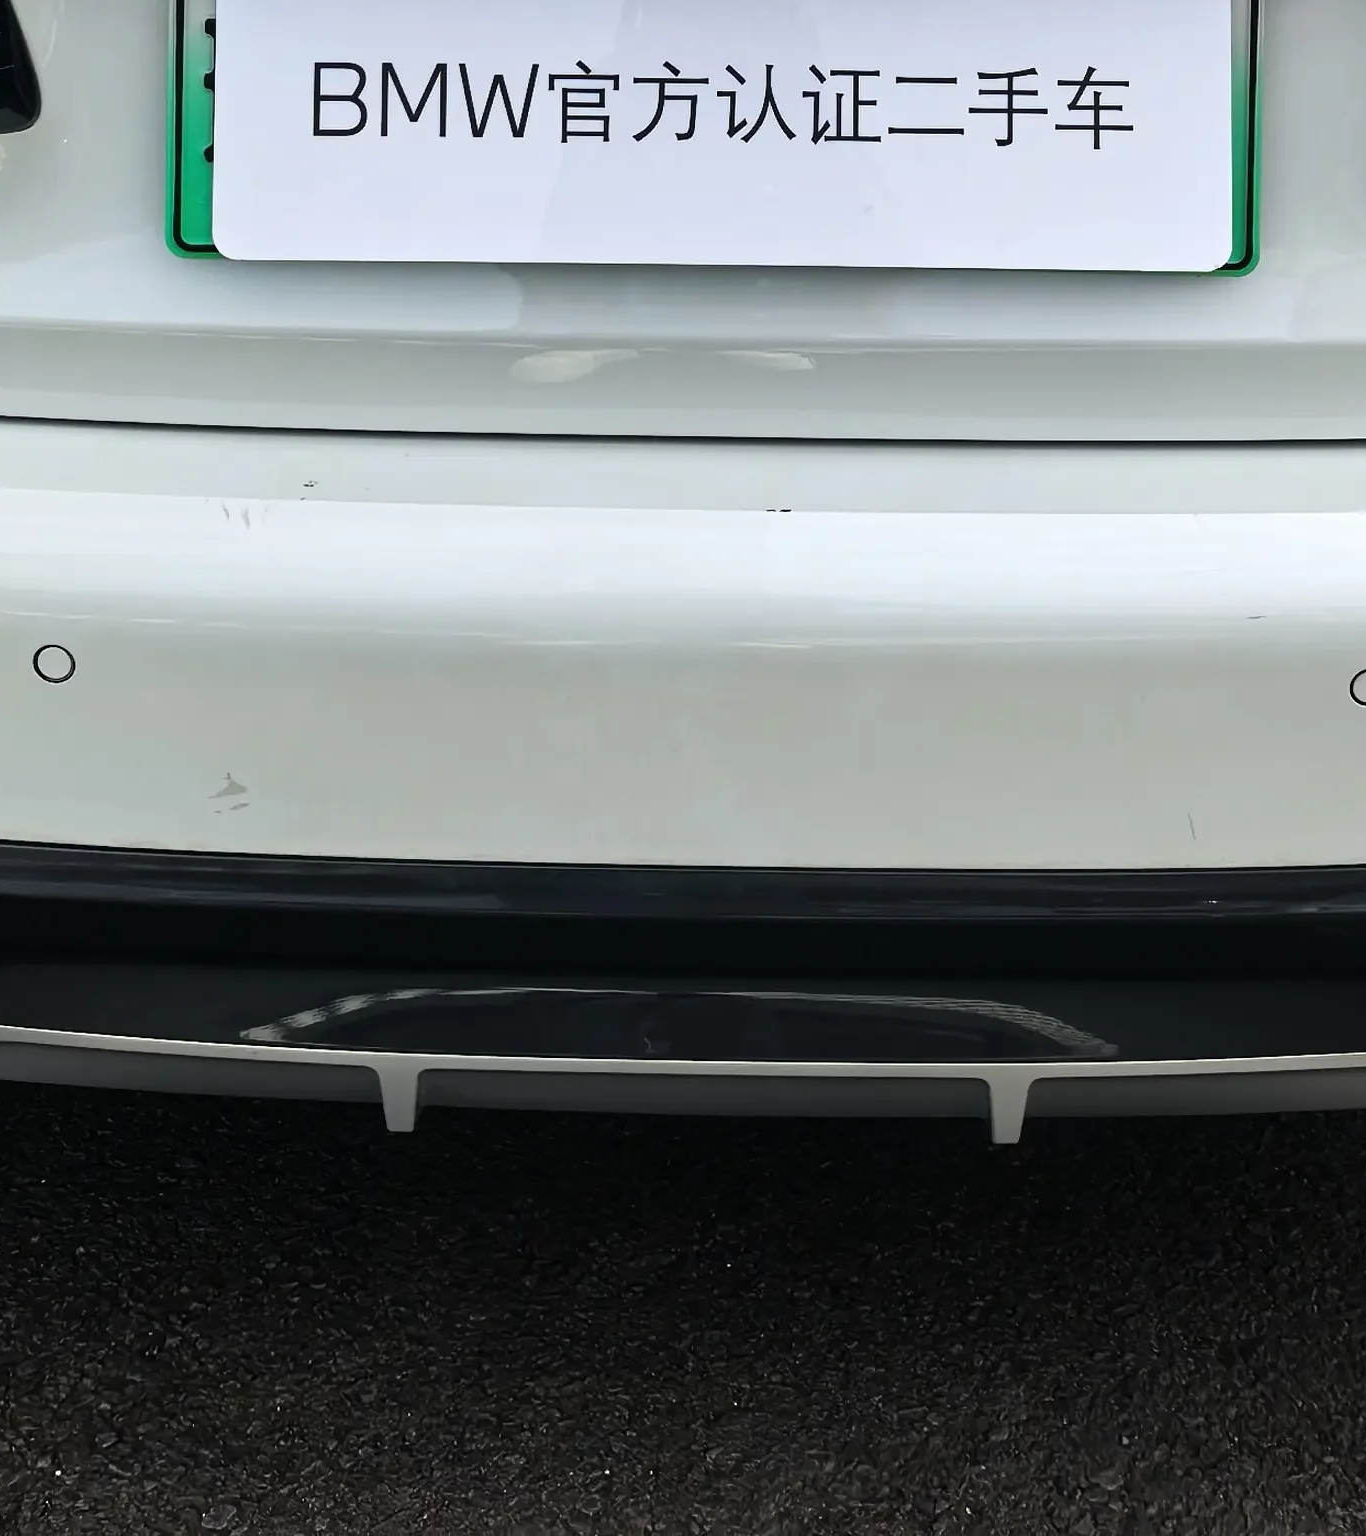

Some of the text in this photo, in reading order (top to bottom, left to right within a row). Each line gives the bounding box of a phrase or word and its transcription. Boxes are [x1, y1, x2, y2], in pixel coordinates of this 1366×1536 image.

[311, 60, 1135, 151] BMW官方认证二手车
